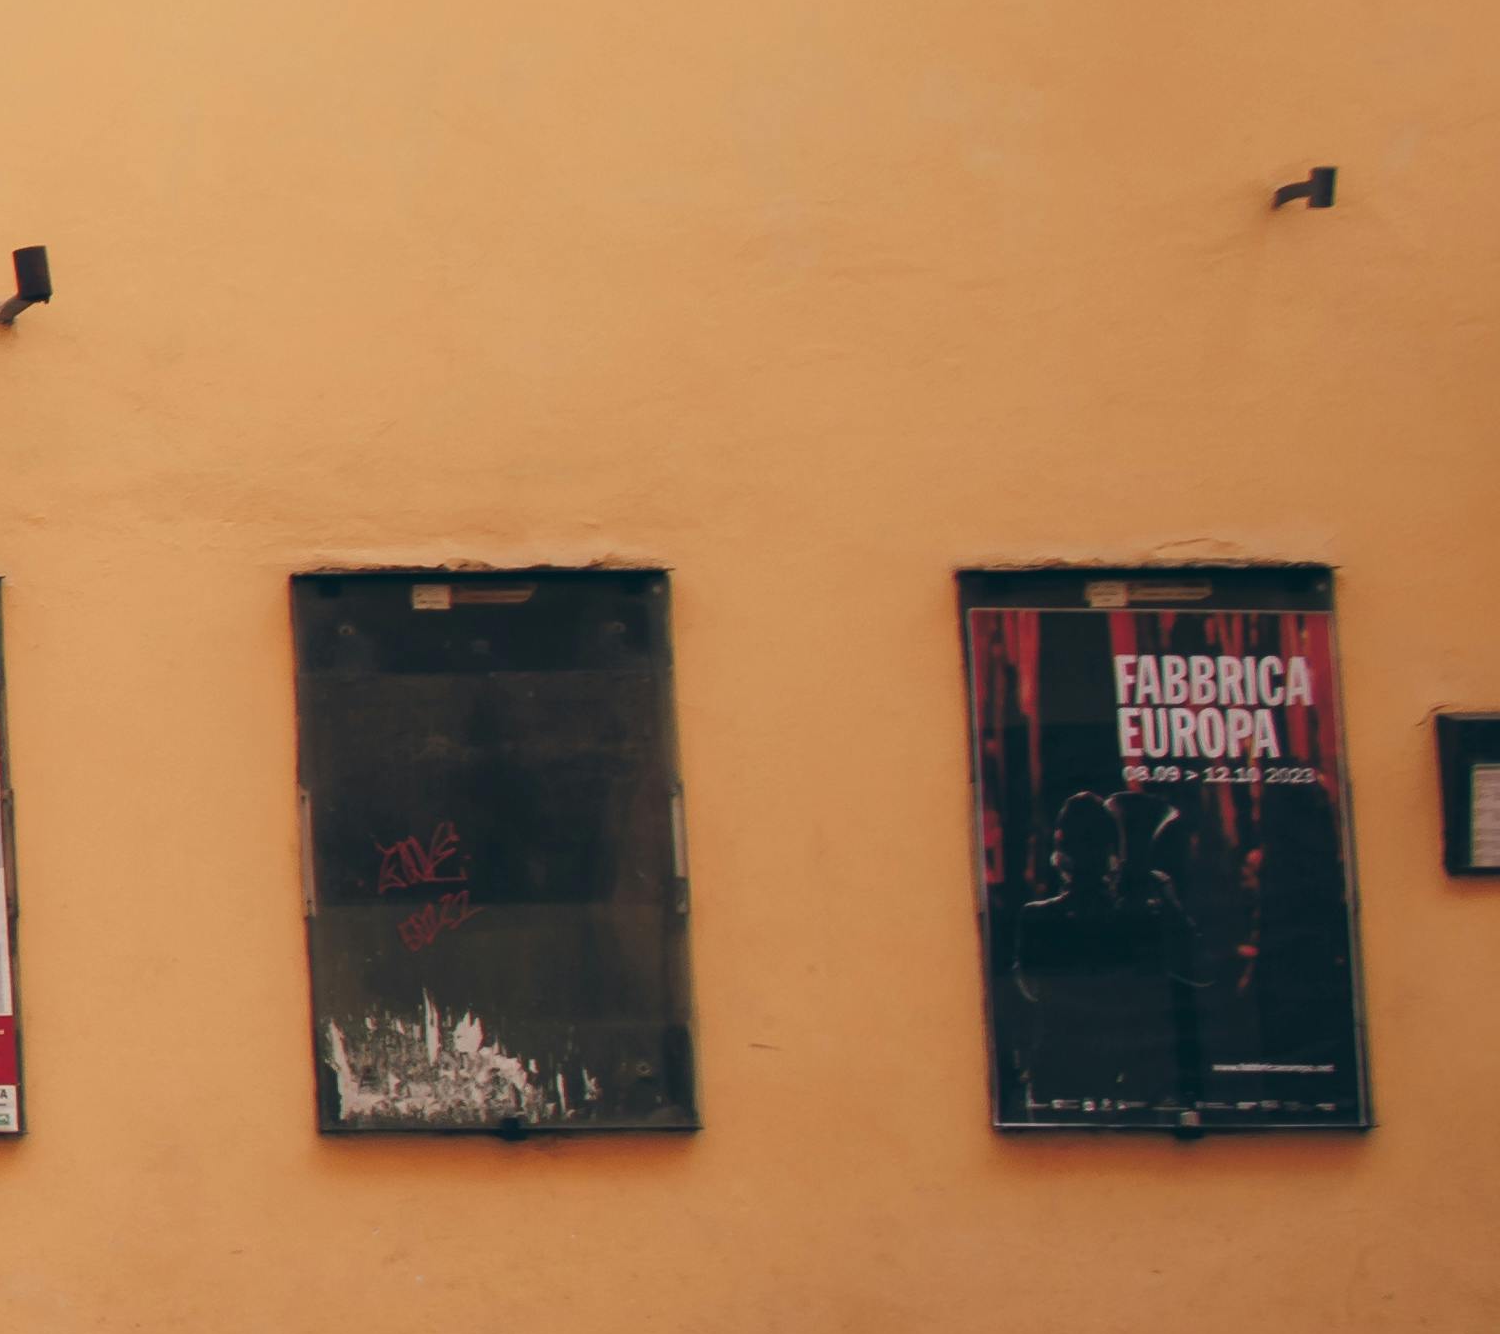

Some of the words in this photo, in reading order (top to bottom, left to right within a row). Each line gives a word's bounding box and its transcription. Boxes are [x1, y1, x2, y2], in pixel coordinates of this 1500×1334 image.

[1114, 655, 1314, 706] FABBRICA
[1116, 707, 1281, 758] EUROPA
[1122, 766, 1181, 782] 08.09
[1264, 768, 1317, 783] 2023
